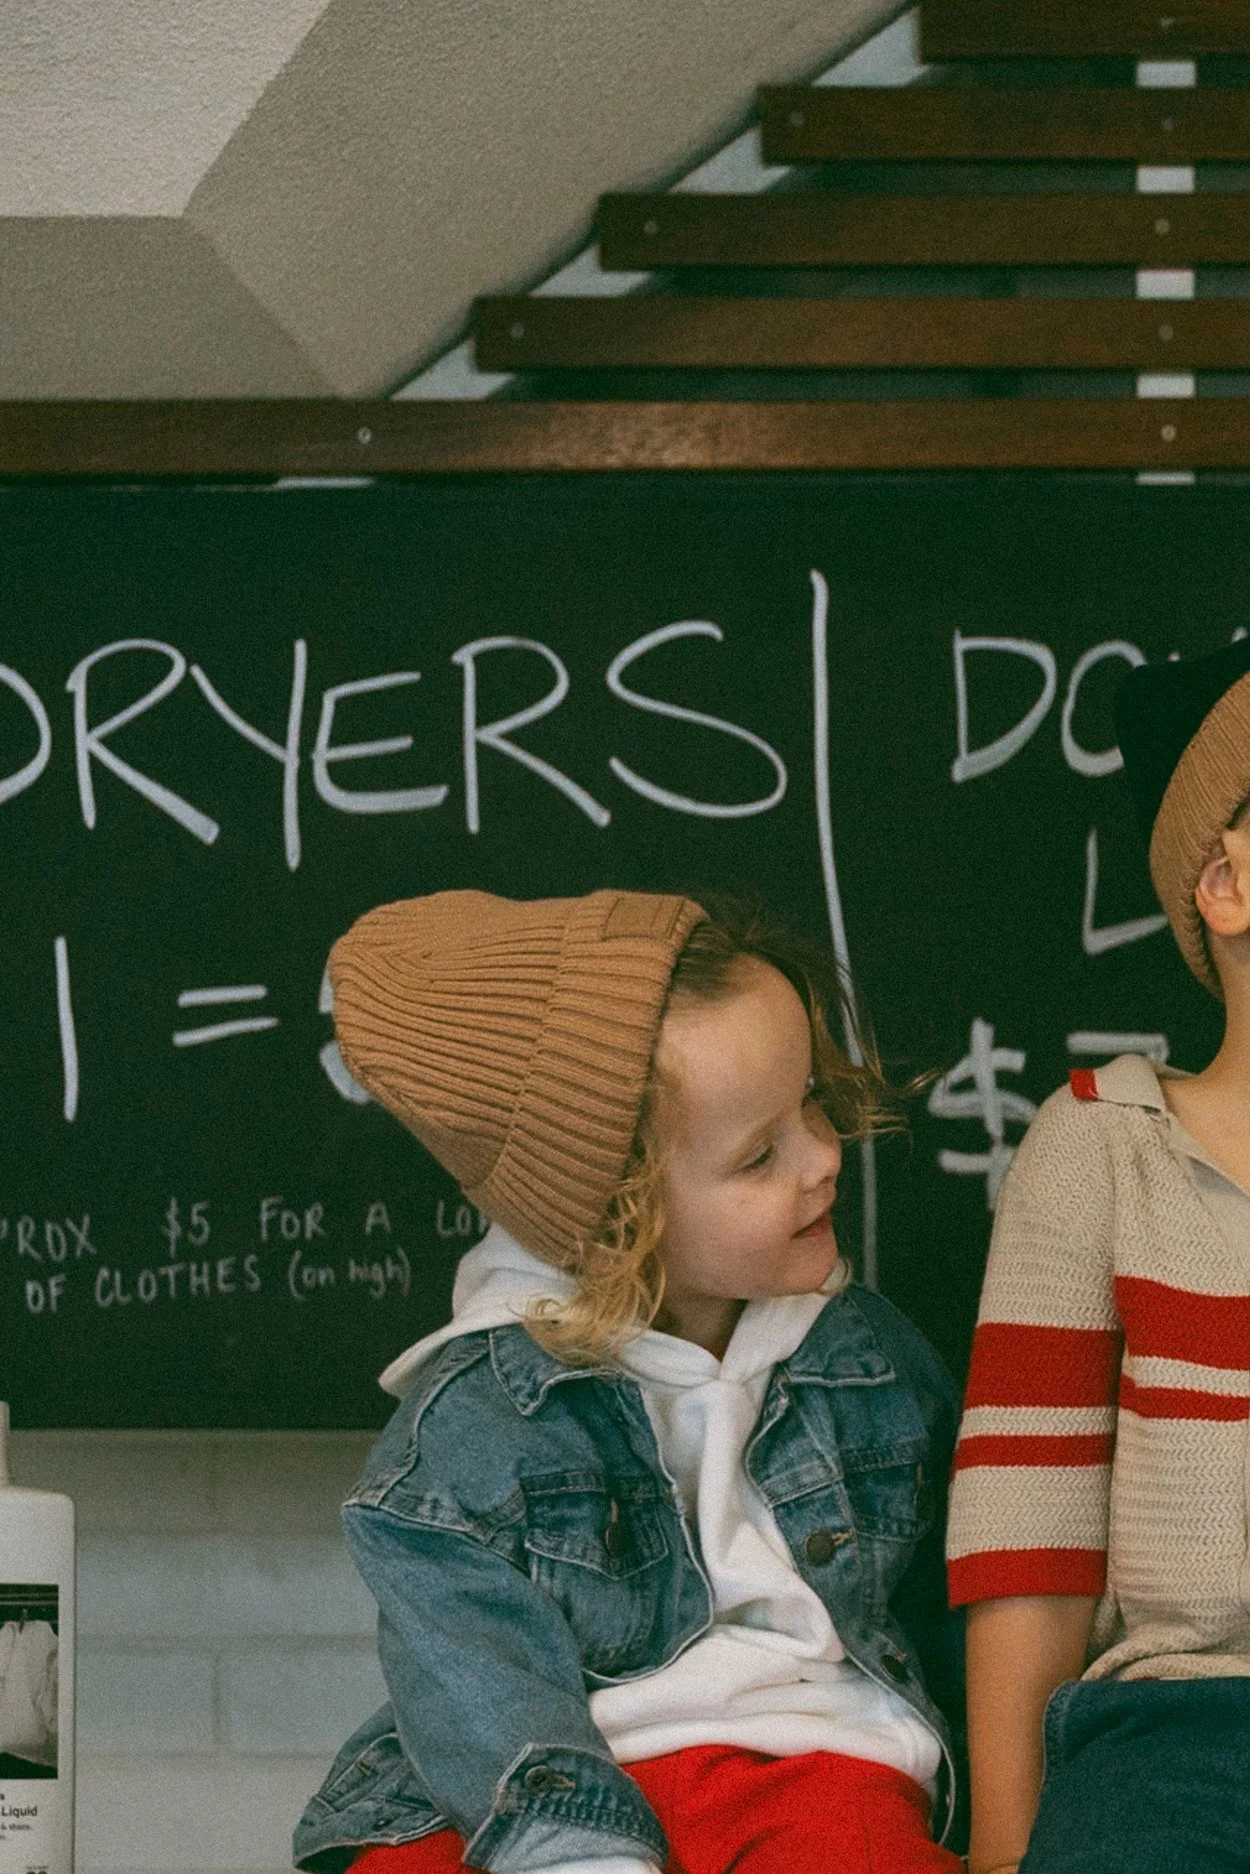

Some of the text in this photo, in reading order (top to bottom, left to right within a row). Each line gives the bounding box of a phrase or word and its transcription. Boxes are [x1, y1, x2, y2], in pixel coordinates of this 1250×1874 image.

[0, 1211, 97, 1263] ROX
[161, 1196, 212, 1259] $5
[259, 1196, 327, 1243] FOR
[364, 1202, 392, 1235] A
[25, 1272, 68, 1314] OF
[94, 1253, 262, 1308] CLOTHES
[1, 1805, 38, 1819] Liquid
